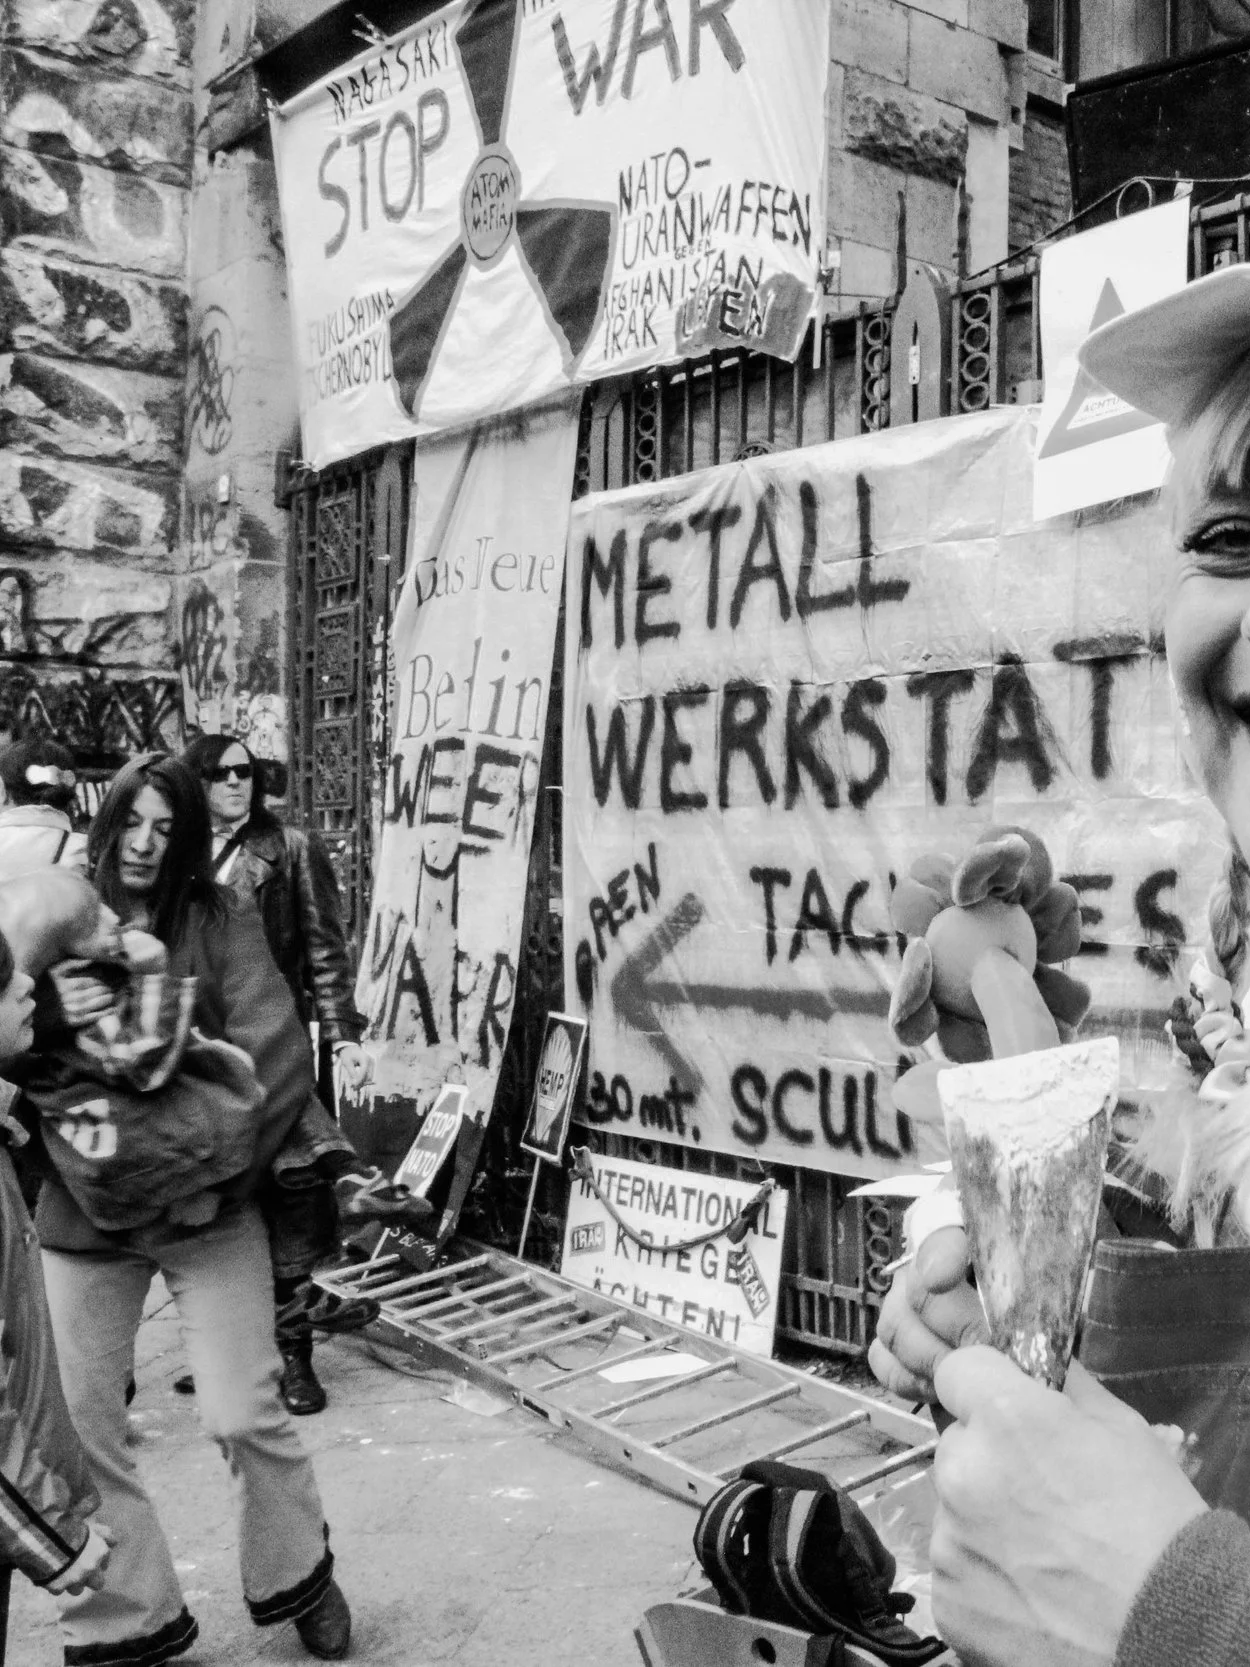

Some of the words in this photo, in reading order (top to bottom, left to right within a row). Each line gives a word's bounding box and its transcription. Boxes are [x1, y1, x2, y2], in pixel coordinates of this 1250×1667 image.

[326, 20, 450, 126] NAGASAKI
[551, 0, 746, 117] WAR
[317, 87, 451, 260] STOP
[470, 172, 511, 208] ATOM
[618, 146, 712, 216] NATO-
[471, 202, 508, 234] MAFIA
[602, 248, 764, 322] AFGHANISTAN
[603, 303, 659, 361] IRAK
[580, 472, 911, 649] METALL
[584, 633, 1168, 812] WERKSTAT
[538, 1067, 566, 1099] HEMP
[586, 1069, 633, 1124] 30
[422, 1111, 458, 1139] STOP
[401, 1149, 438, 1178] NATO
